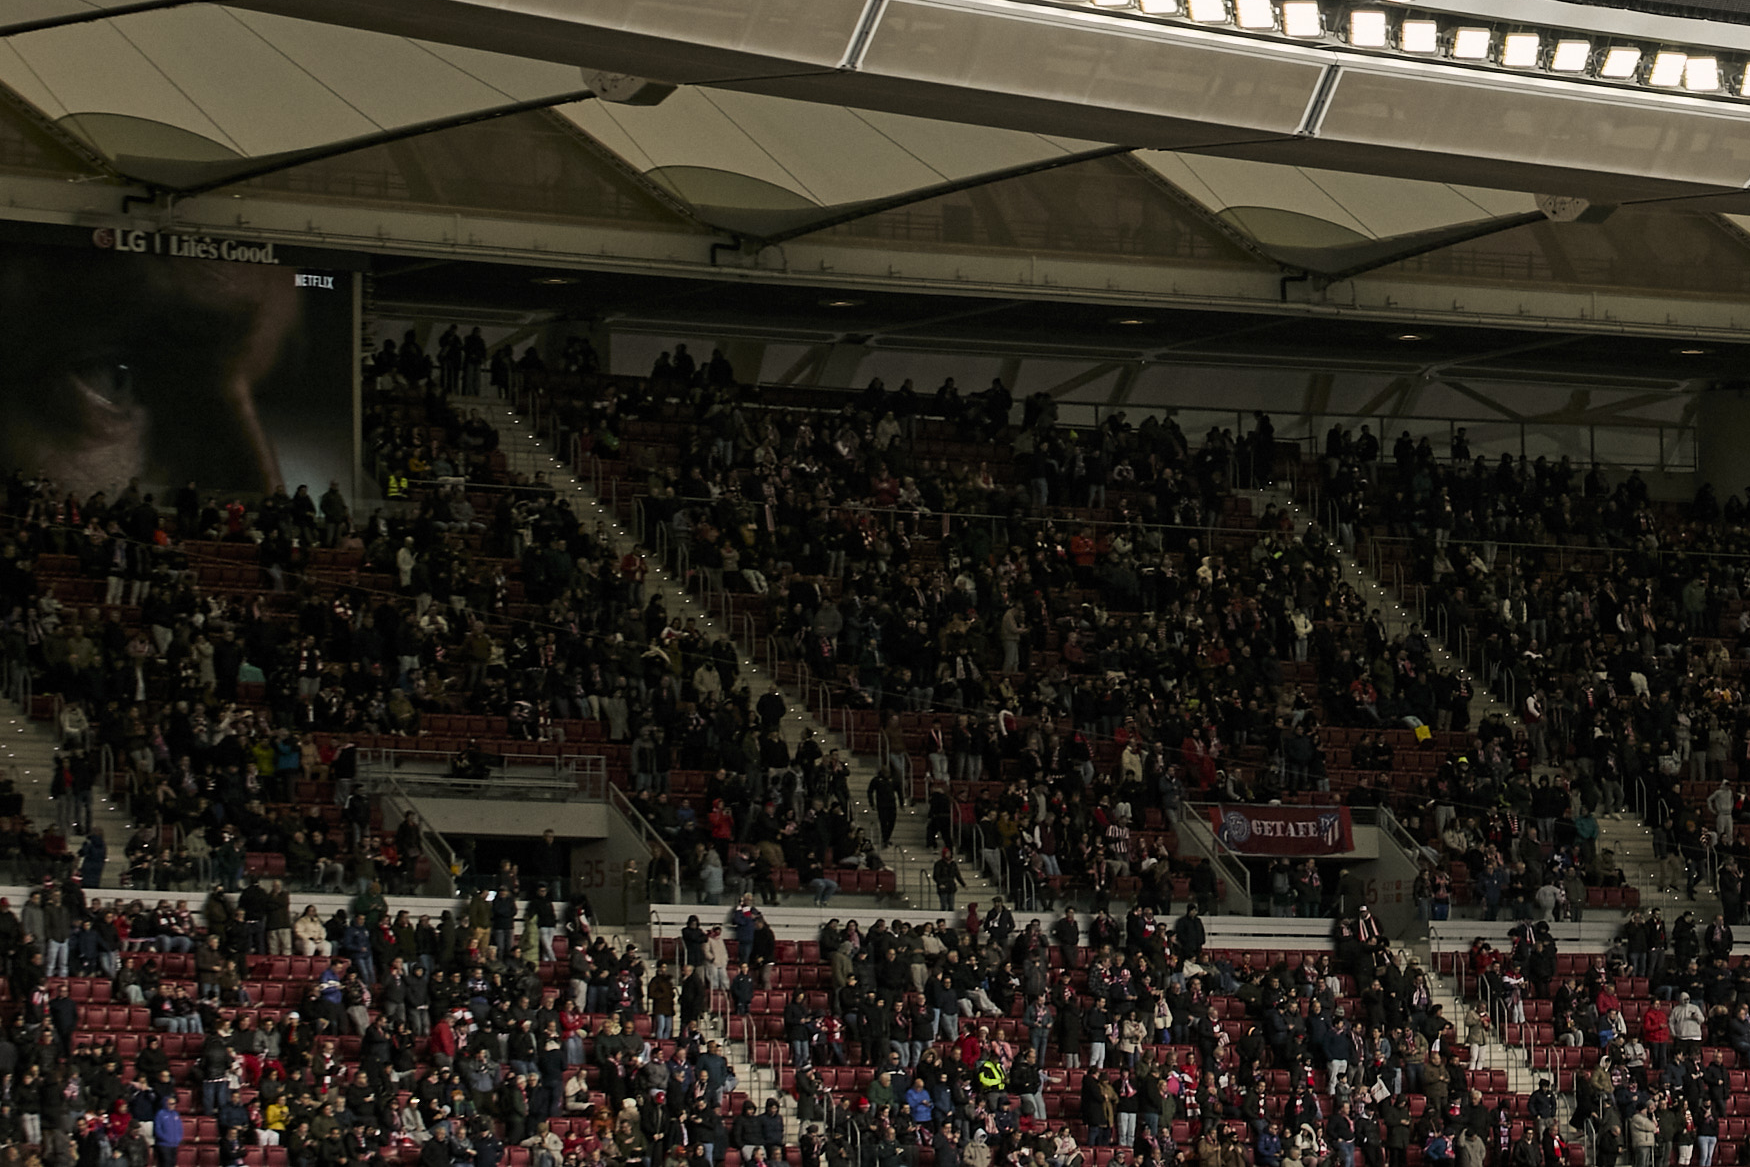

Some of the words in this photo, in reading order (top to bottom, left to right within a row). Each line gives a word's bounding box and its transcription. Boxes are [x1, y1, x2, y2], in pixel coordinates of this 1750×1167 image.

[115, 228, 147, 253] LG
[169, 234, 219, 260] Life's
[220, 239, 280, 265] Good.
[294, 273, 335, 290] NETFLIX
[1251, 819, 1319, 838] GETAFE
